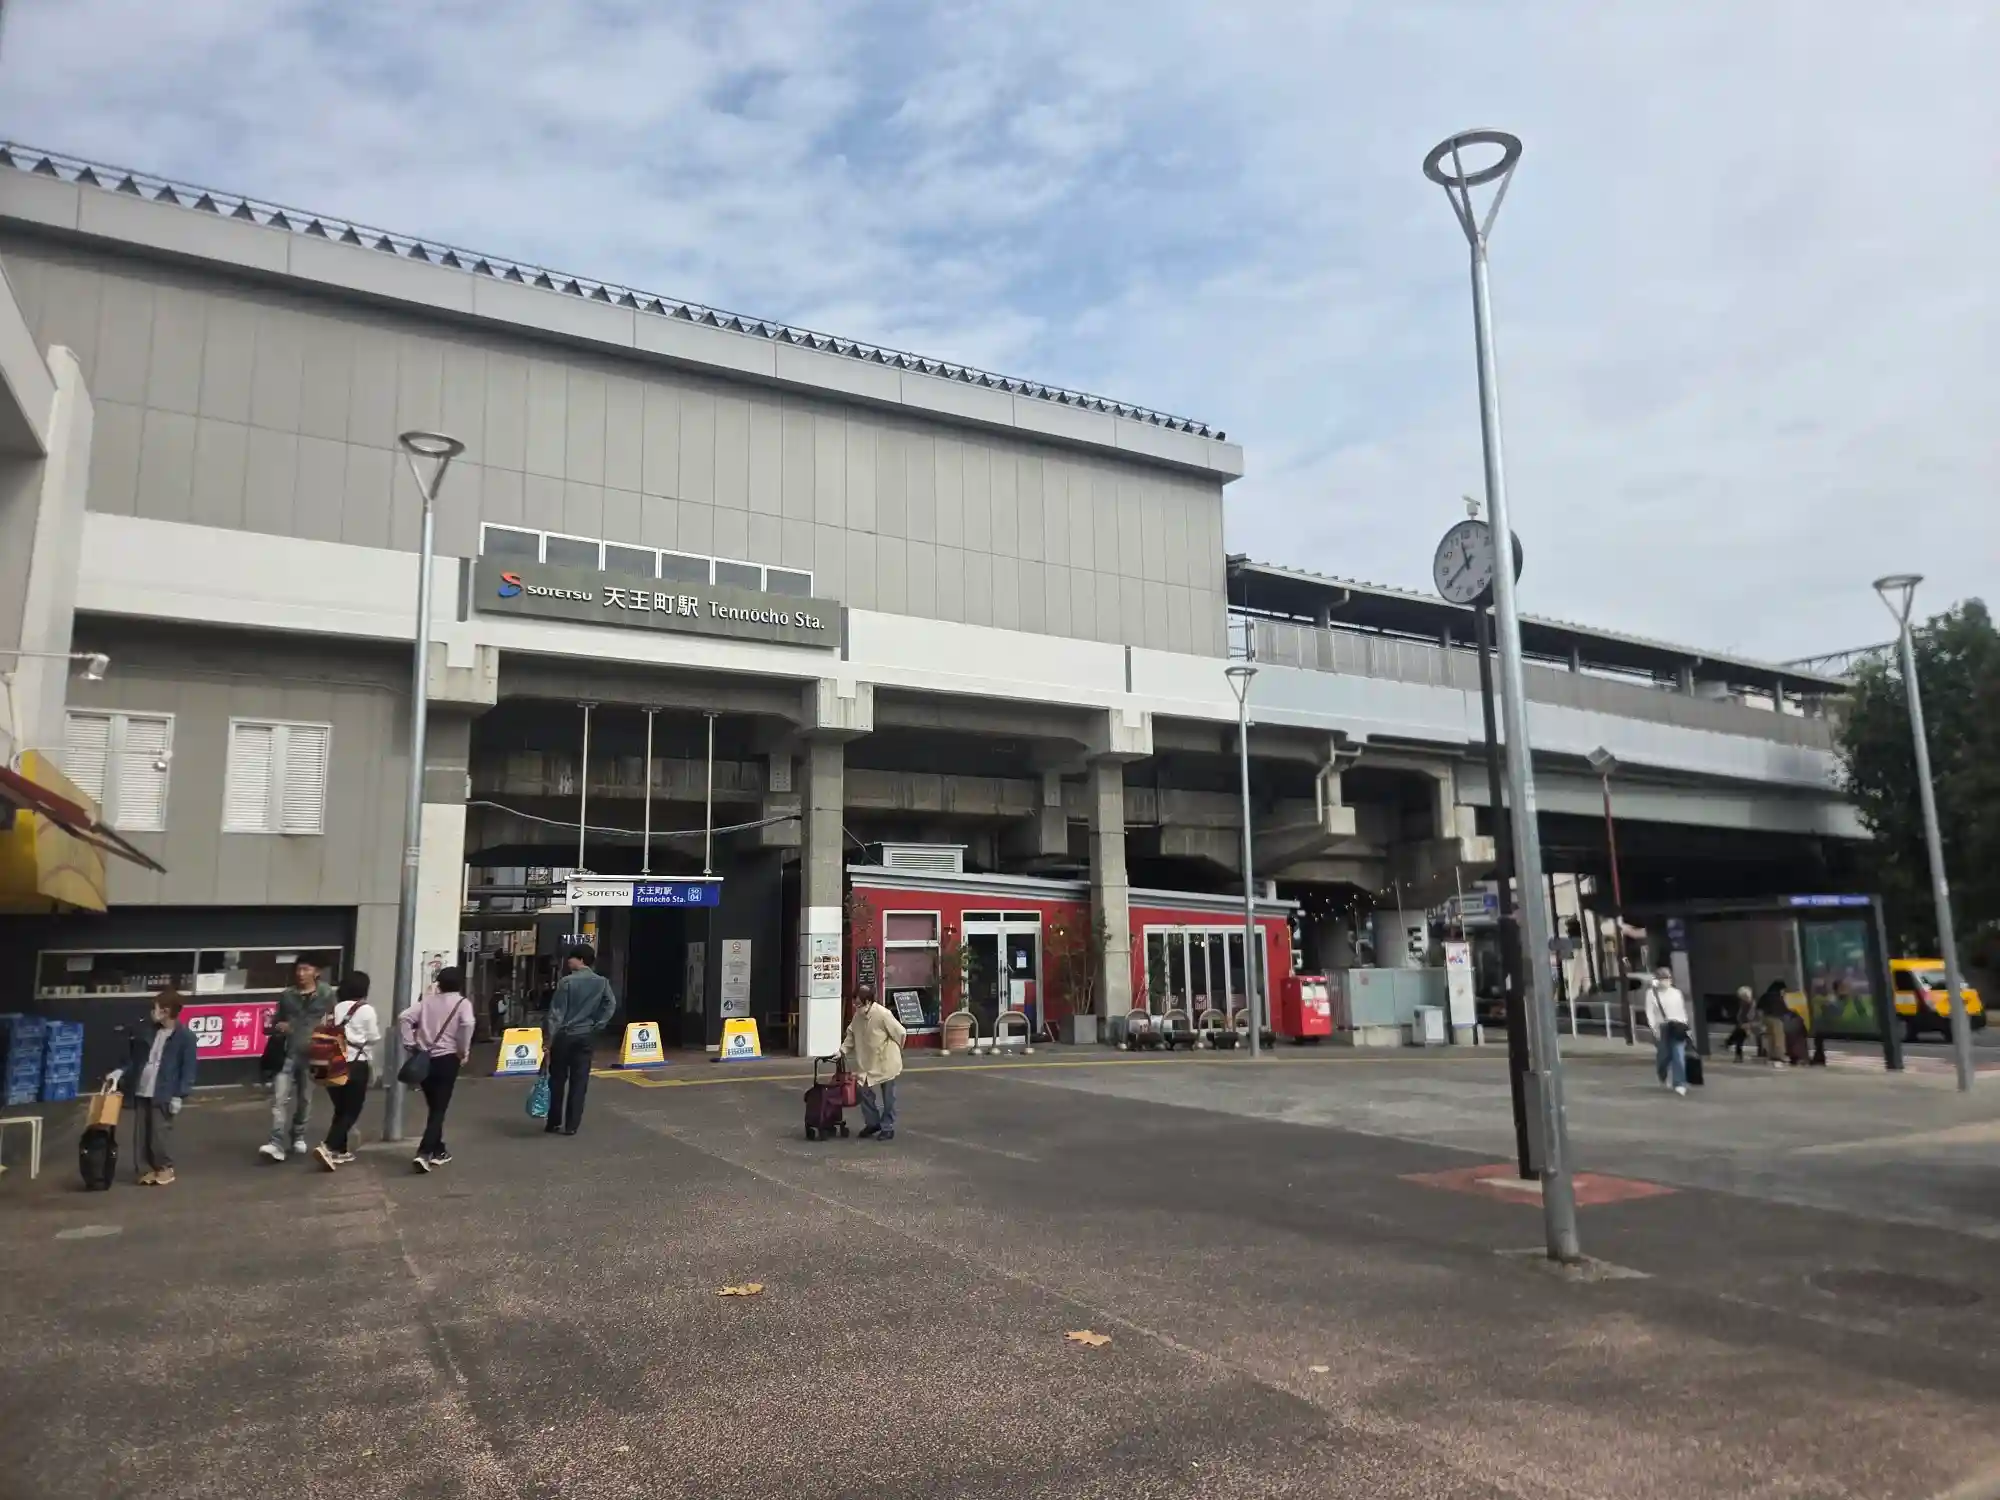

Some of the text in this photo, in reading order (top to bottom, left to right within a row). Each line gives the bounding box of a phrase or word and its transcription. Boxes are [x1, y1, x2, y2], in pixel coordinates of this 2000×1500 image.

[527, 585, 825, 629] SOTETSU 天王町駅 Tennōchō Sta.
[637, 886, 673, 895] 天王町駅
[672, 895, 686, 903] Sta.
